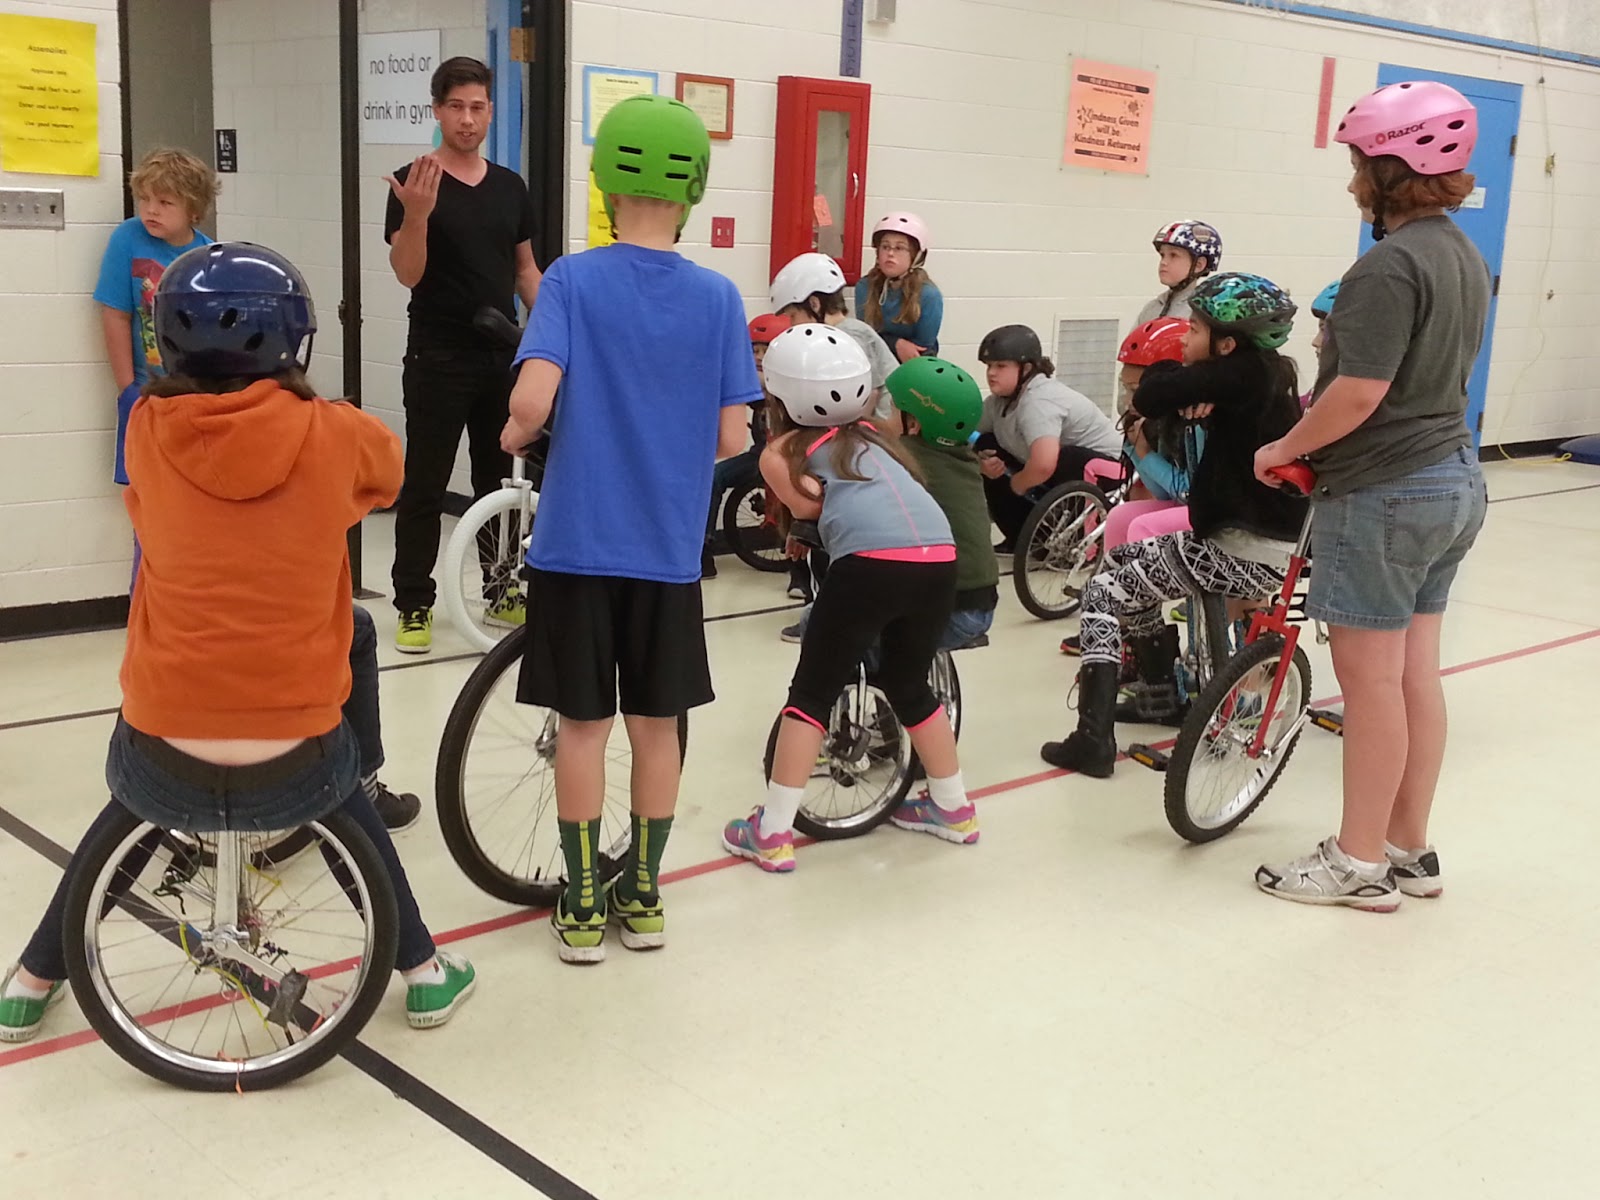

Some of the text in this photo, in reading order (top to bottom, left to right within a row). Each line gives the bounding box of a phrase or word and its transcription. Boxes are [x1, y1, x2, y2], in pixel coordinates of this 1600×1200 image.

[370, 53, 432, 74] no food or
[363, 101, 392, 120] drink
[395, 100, 406, 119] in
[1096, 125, 1109, 134] will
[1387, 121, 1426, 140] Razor
[1074, 133, 1140, 151] Kindness Returned
